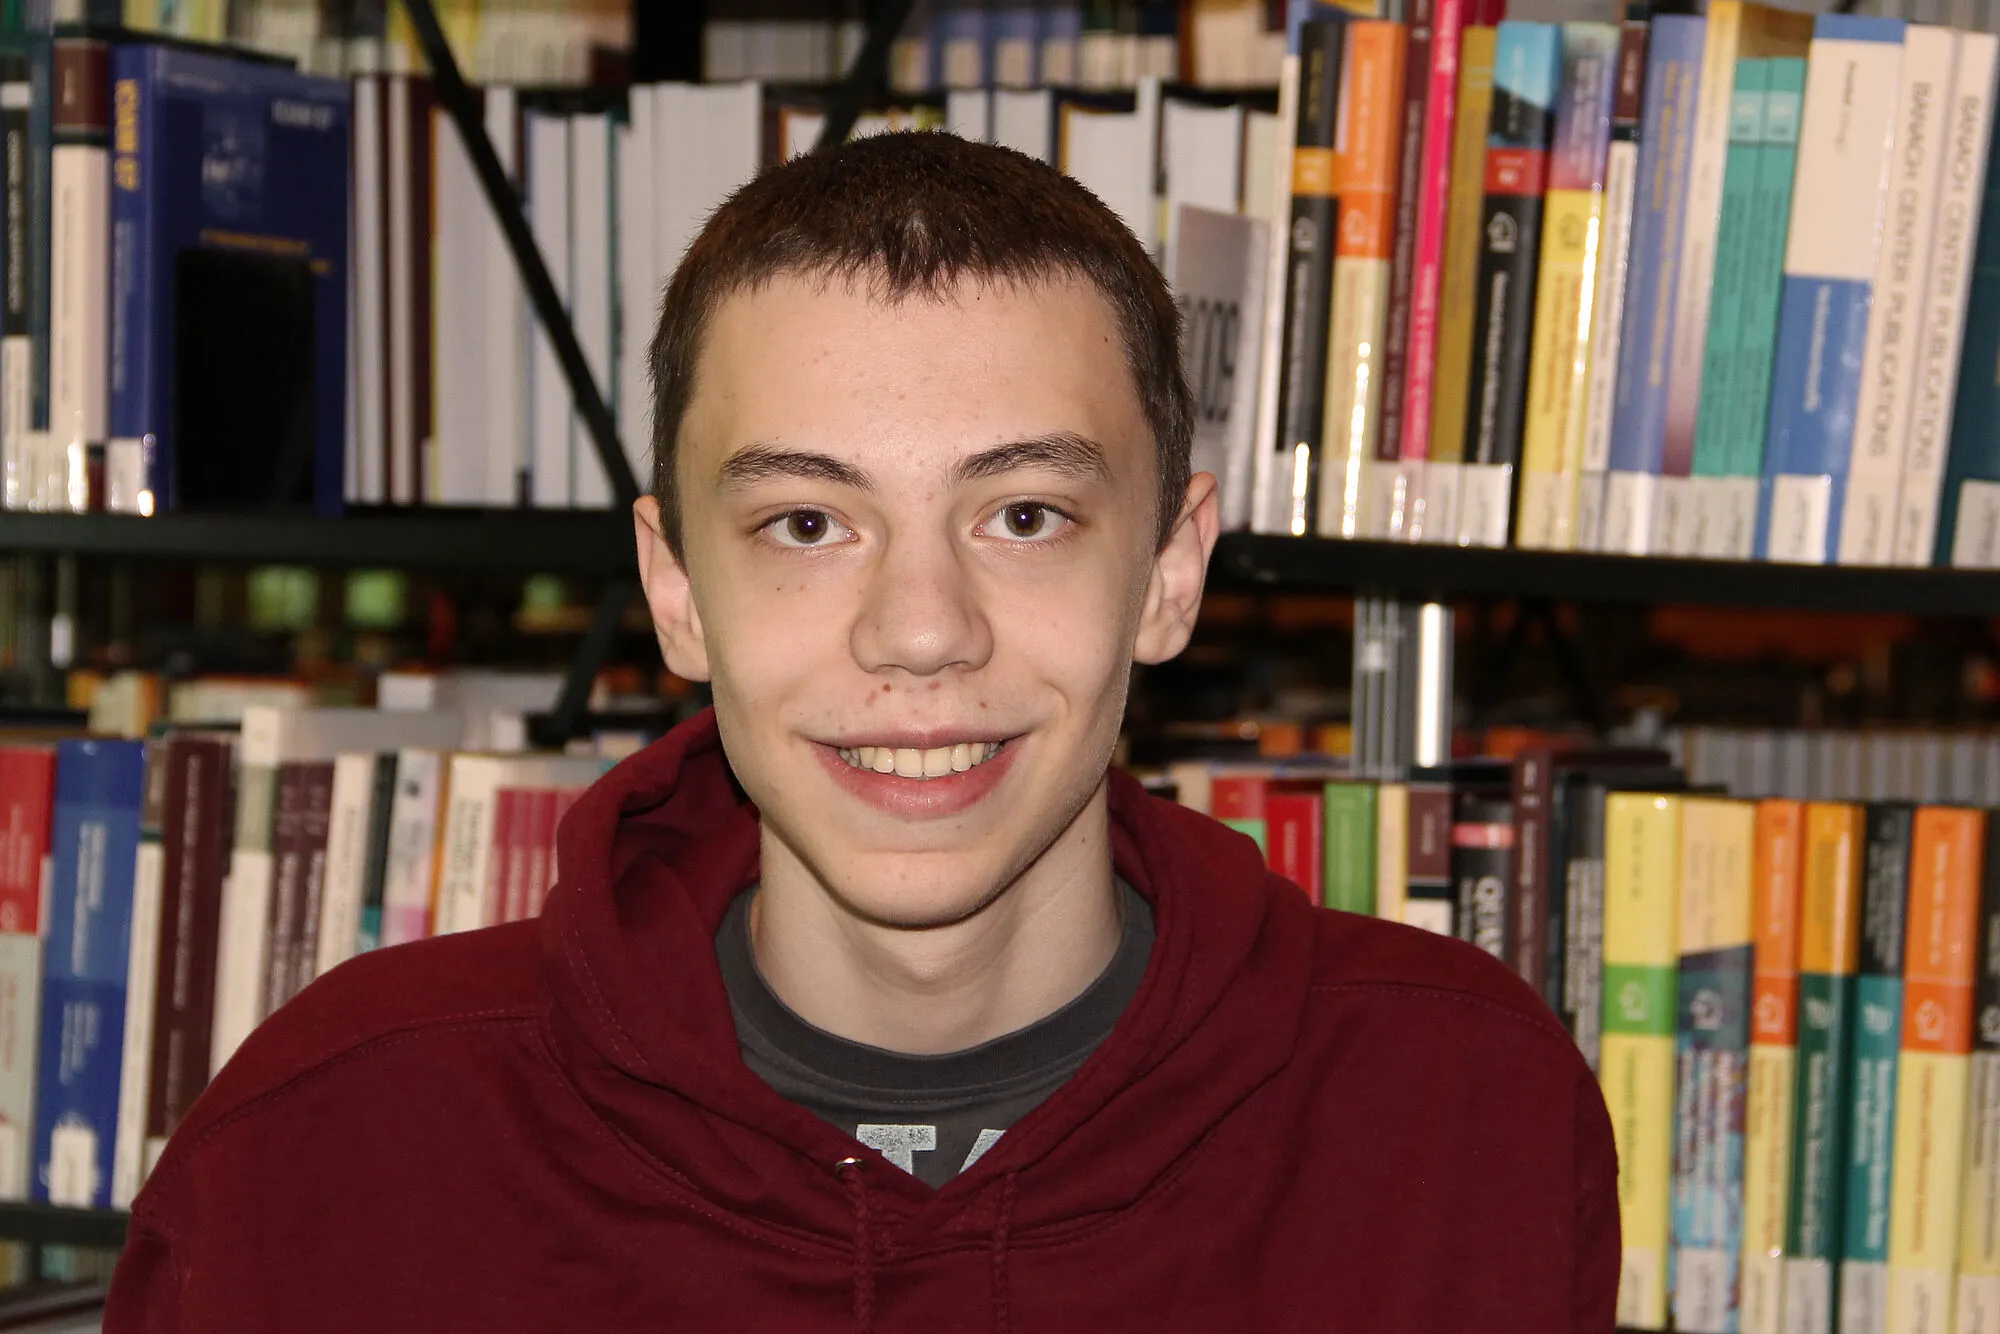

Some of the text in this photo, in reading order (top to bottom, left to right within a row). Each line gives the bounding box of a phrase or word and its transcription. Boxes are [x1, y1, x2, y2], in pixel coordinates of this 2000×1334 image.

[1869, 81, 1932, 458] BANACH CENTER PUBLICATIONS
[1913, 94, 1981, 474] BANACH CENTER PUBLICATIONS
